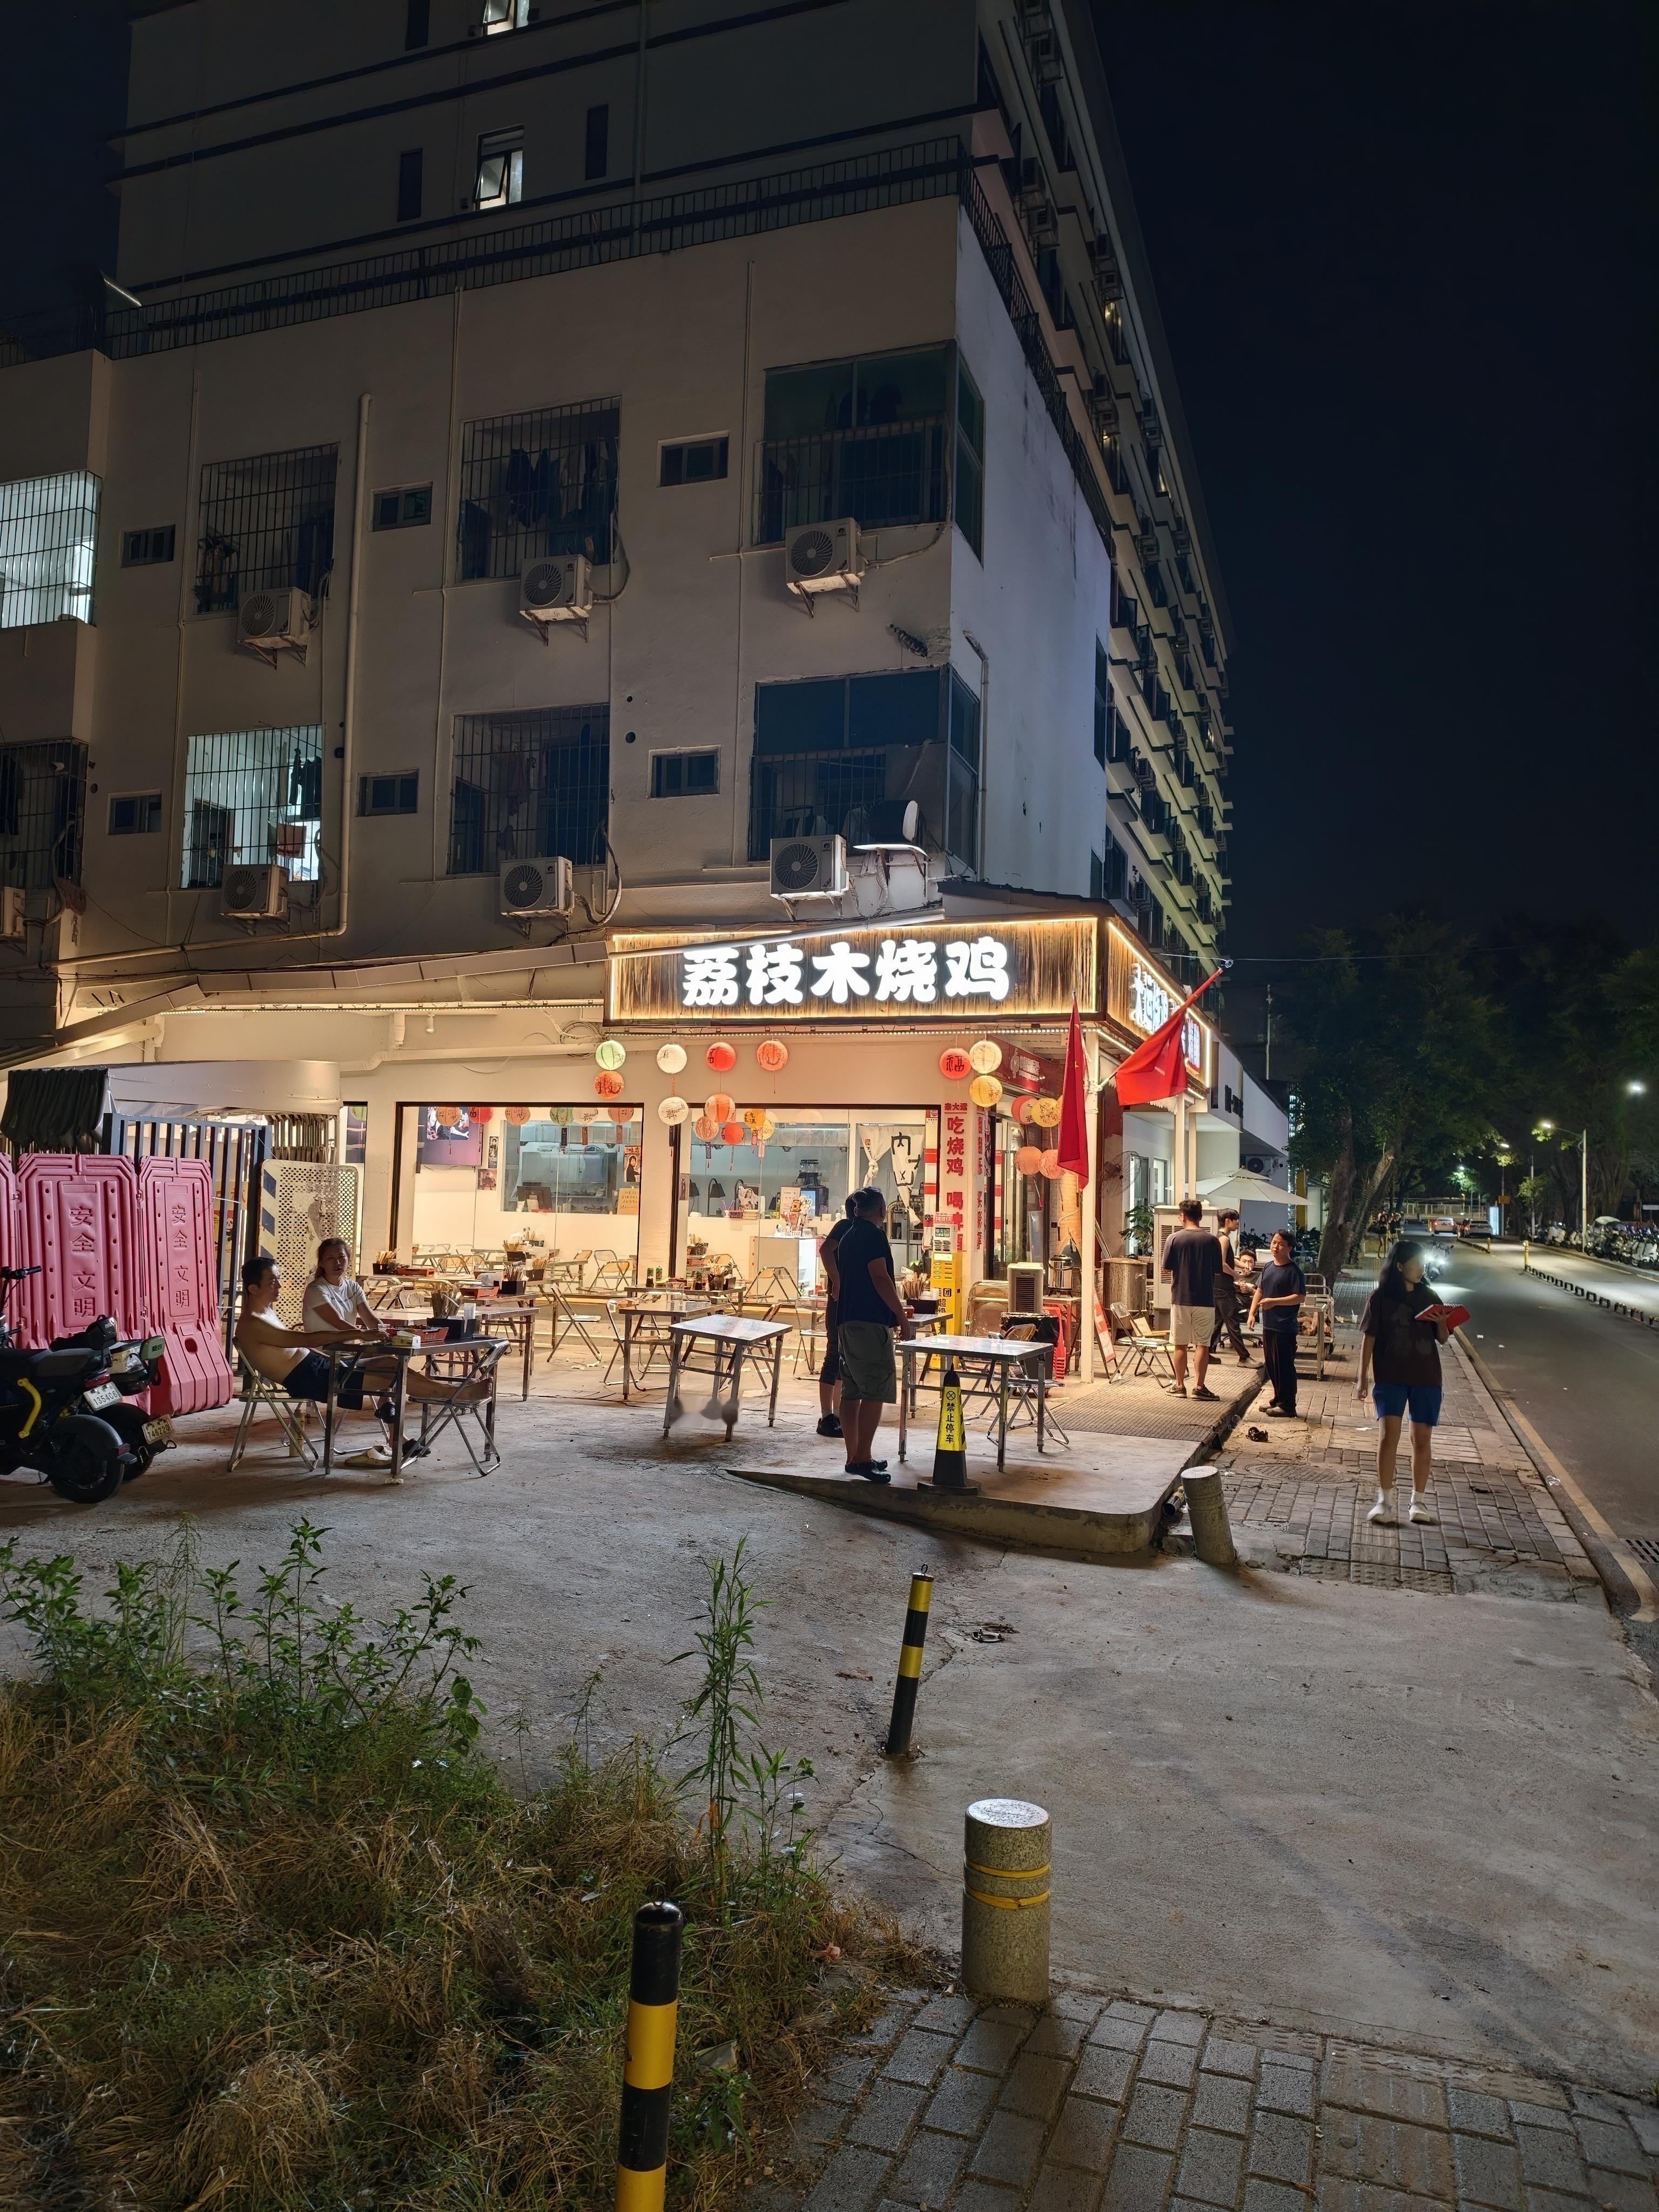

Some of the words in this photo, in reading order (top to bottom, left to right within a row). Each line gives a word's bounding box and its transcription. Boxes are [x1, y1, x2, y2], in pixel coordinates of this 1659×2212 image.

[682, 936, 1010, 1007] 荔枝木烧鸡
[946, 1055, 964, 1072] 福
[947, 1116, 964, 1176] 吃烧鸡
[70, 1206, 96, 1318] 安全文明
[172, 1205, 189, 1307] 安全文明
[946, 1402, 955, 1444] 禁止停车
